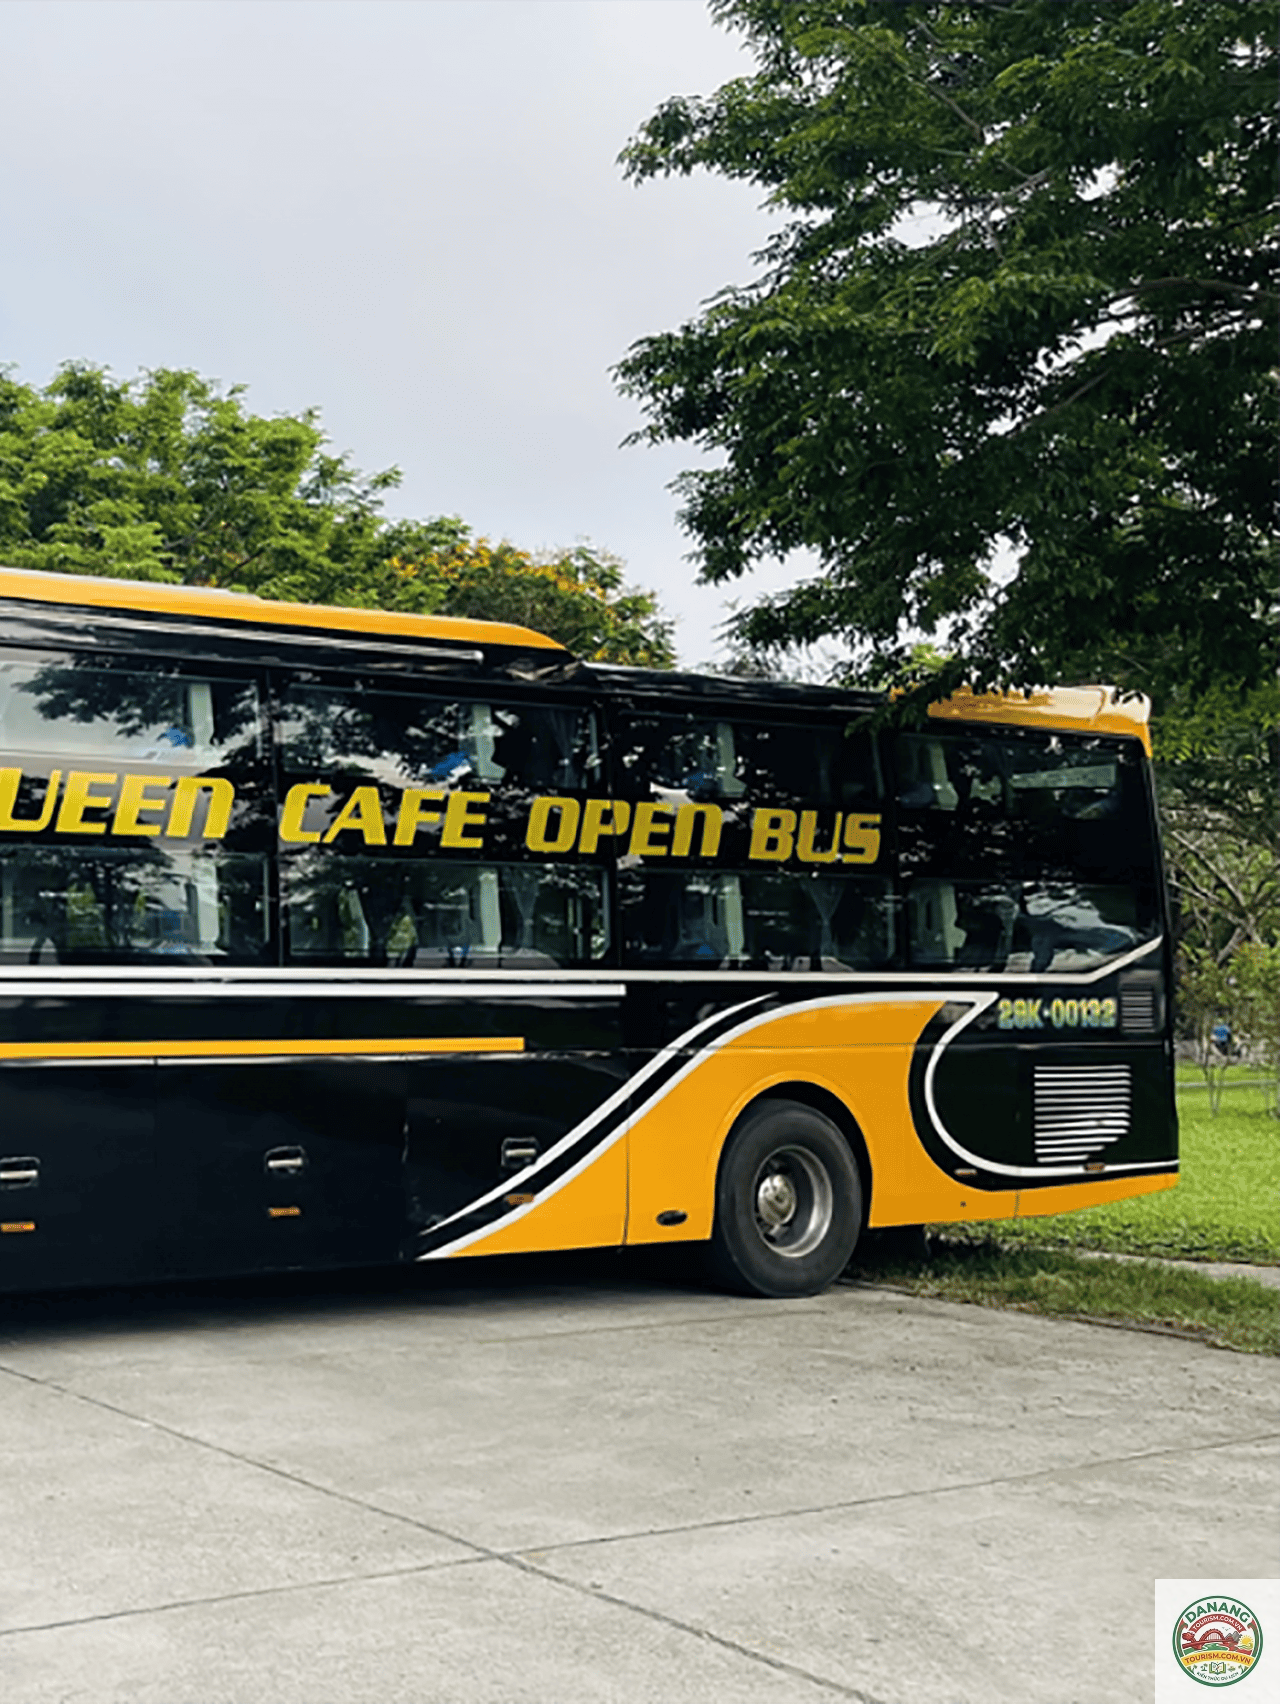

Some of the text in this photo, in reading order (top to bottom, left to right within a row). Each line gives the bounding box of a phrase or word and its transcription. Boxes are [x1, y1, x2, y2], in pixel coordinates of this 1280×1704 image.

[278, 783, 490, 848] CAFE
[525, 796, 722, 857] OPEN
[748, 807, 881, 864] BUS
